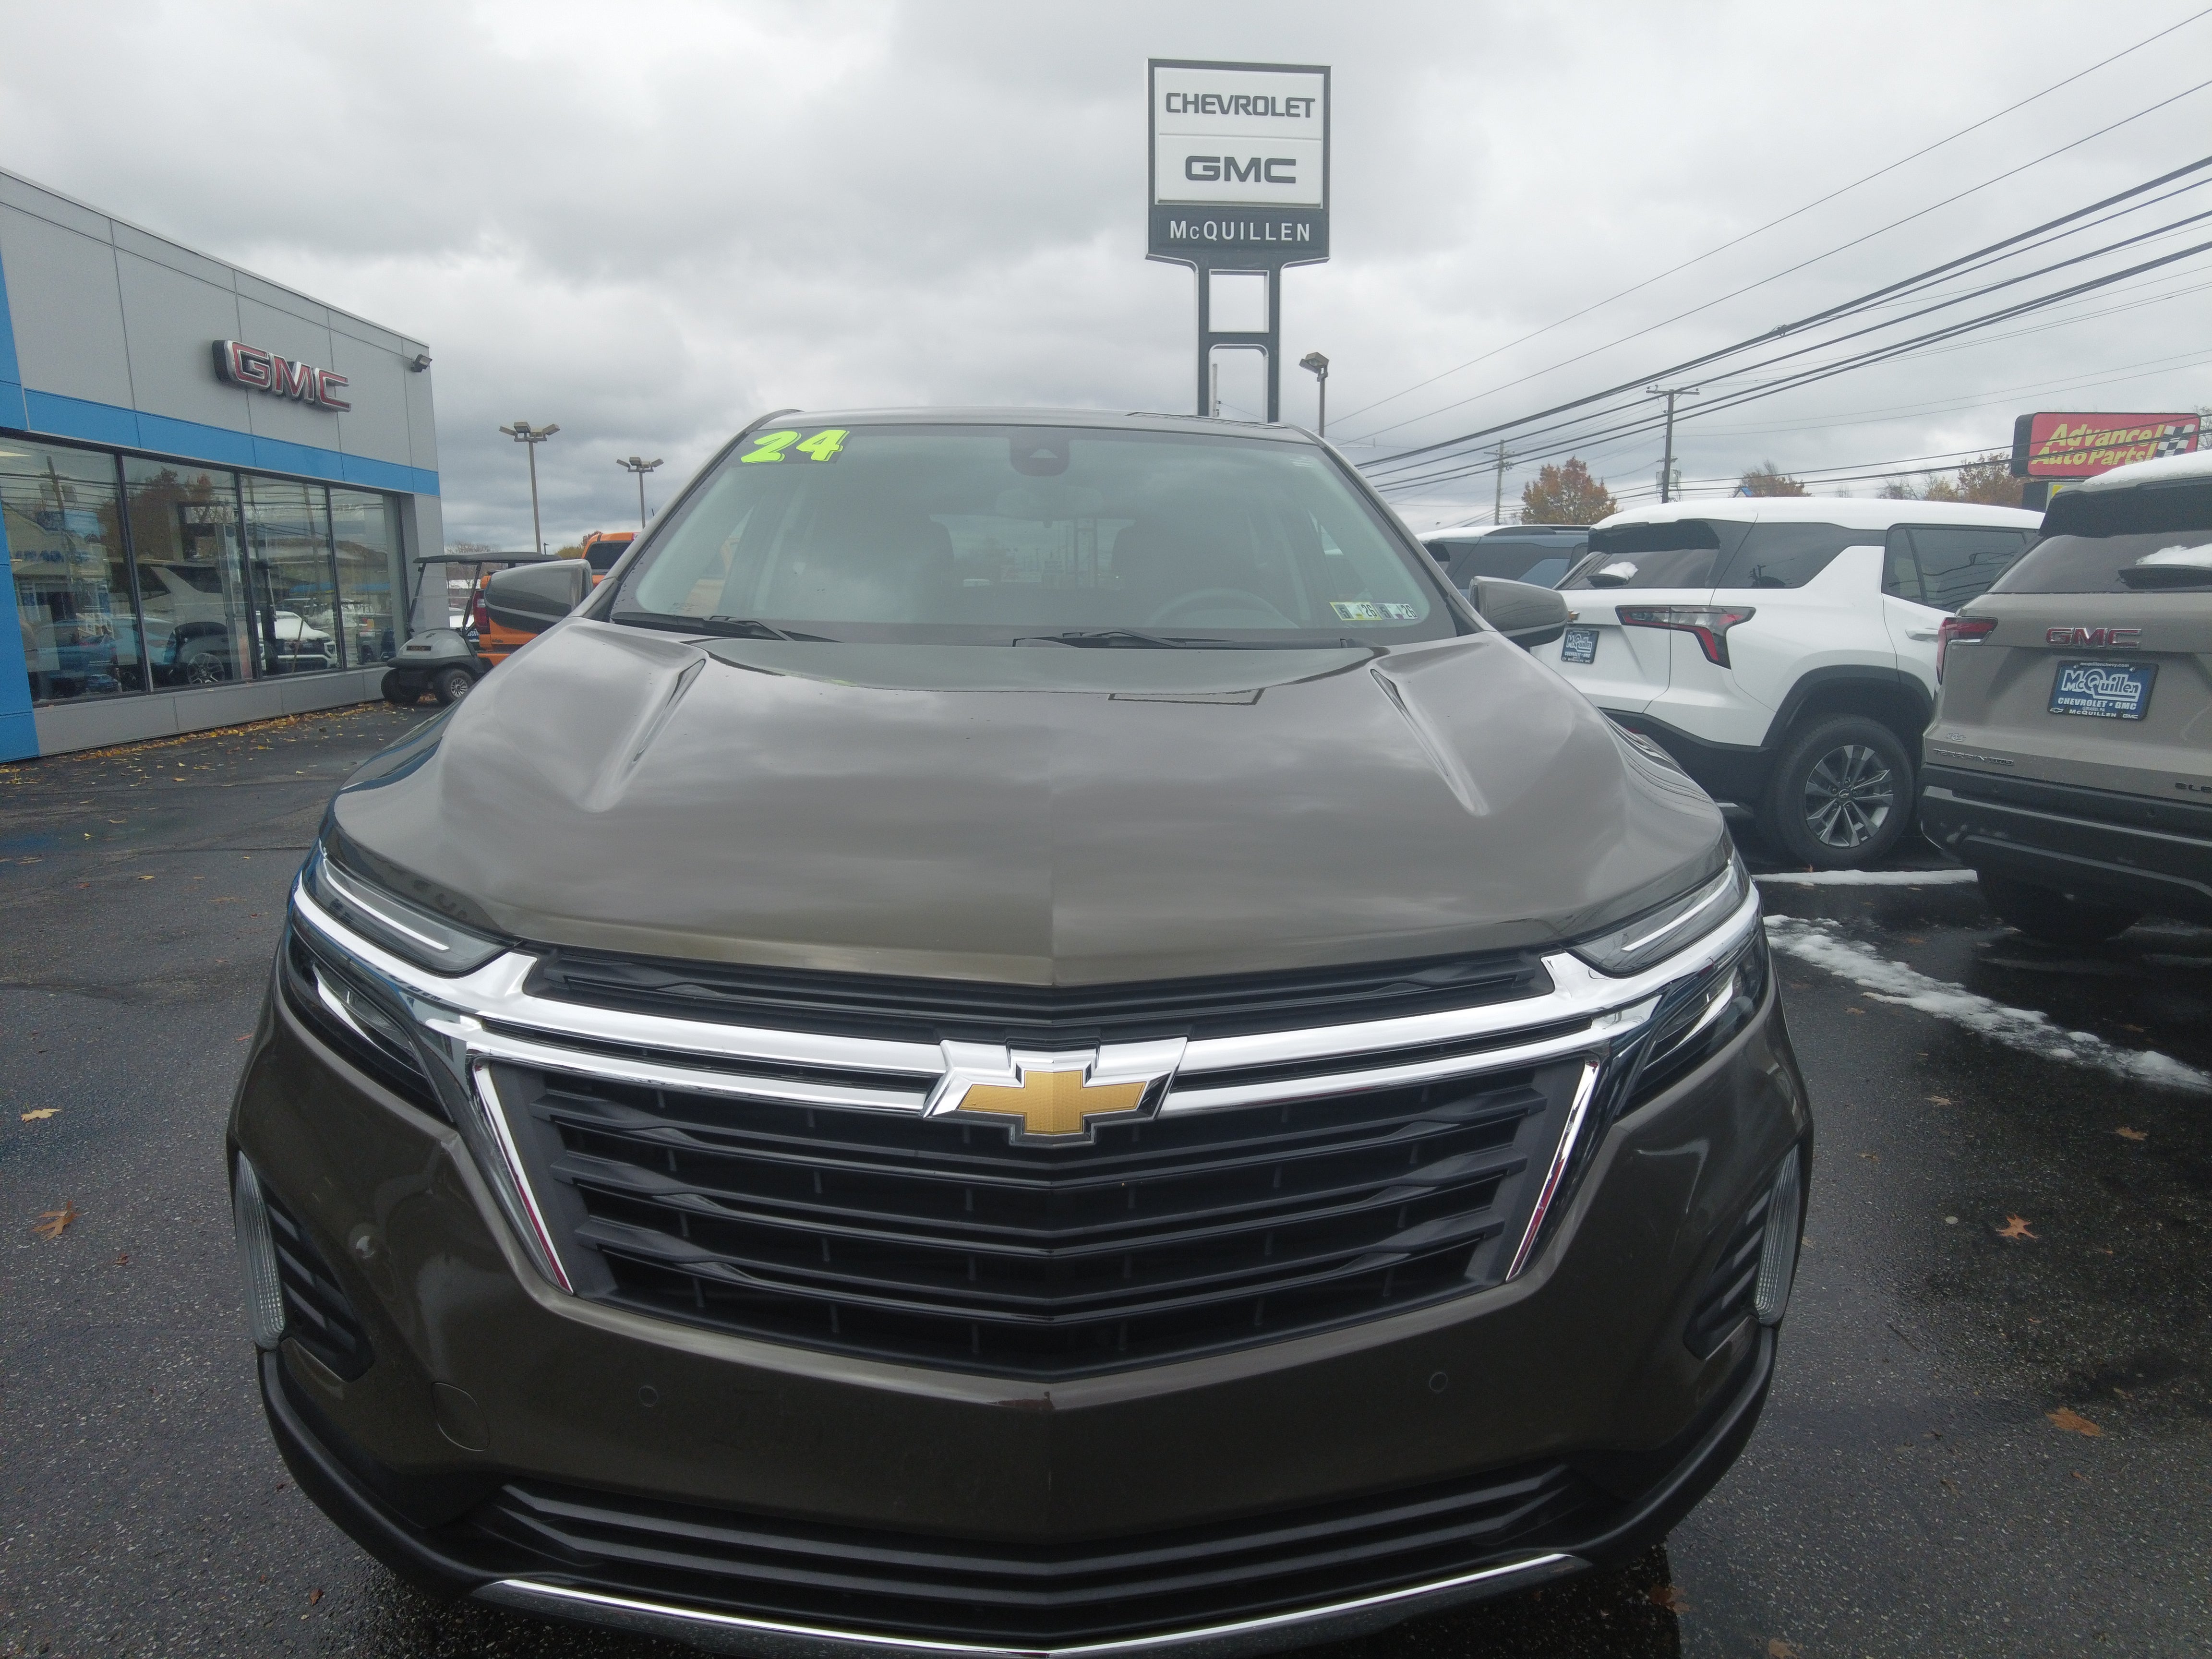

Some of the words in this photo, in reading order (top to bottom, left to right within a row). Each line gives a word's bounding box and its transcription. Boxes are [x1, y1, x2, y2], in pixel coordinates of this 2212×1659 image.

[1166, 93, 1315, 118] CHEVROLET
[1185, 156, 1296, 183] GMC
[1169, 220, 1310, 241] McQUILLEN
[219, 340, 352, 412] GMC
[2045, 424, 2152, 447] Advance
[741, 430, 850, 463] 24
[2031, 446, 2087, 465] Auto
[1360, 604, 1378, 617] 26
[1401, 604, 1417, 617] 26
[2046, 627, 2141, 648] GMC
[2061, 668, 2141, 702] McQuillen
[2057, 697, 2108, 708] CHEVROLET
[2115, 702, 2137, 710] GMC
[2069, 709, 2117, 717] McQUILLEN
